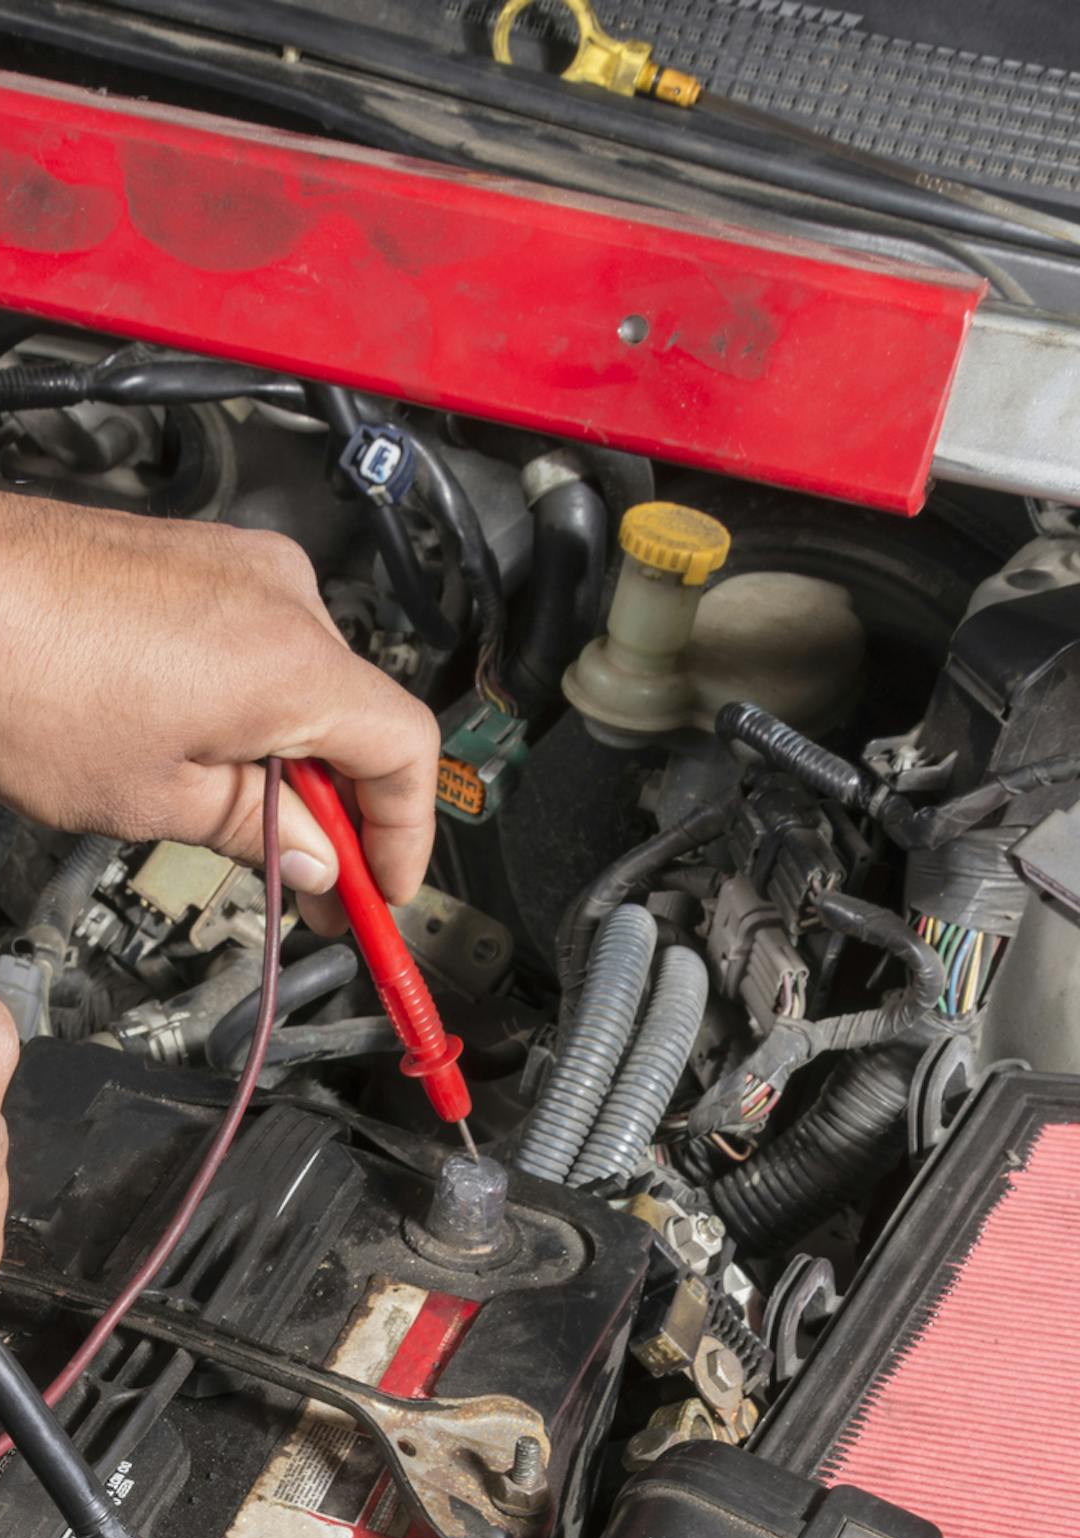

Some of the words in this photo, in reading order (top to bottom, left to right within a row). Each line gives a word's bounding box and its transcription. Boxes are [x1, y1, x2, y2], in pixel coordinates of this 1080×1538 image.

[117, 1461, 132, 1474] DO
[107, 1472, 125, 1490] NOT
[116, 1479, 135, 1498] KEEP
